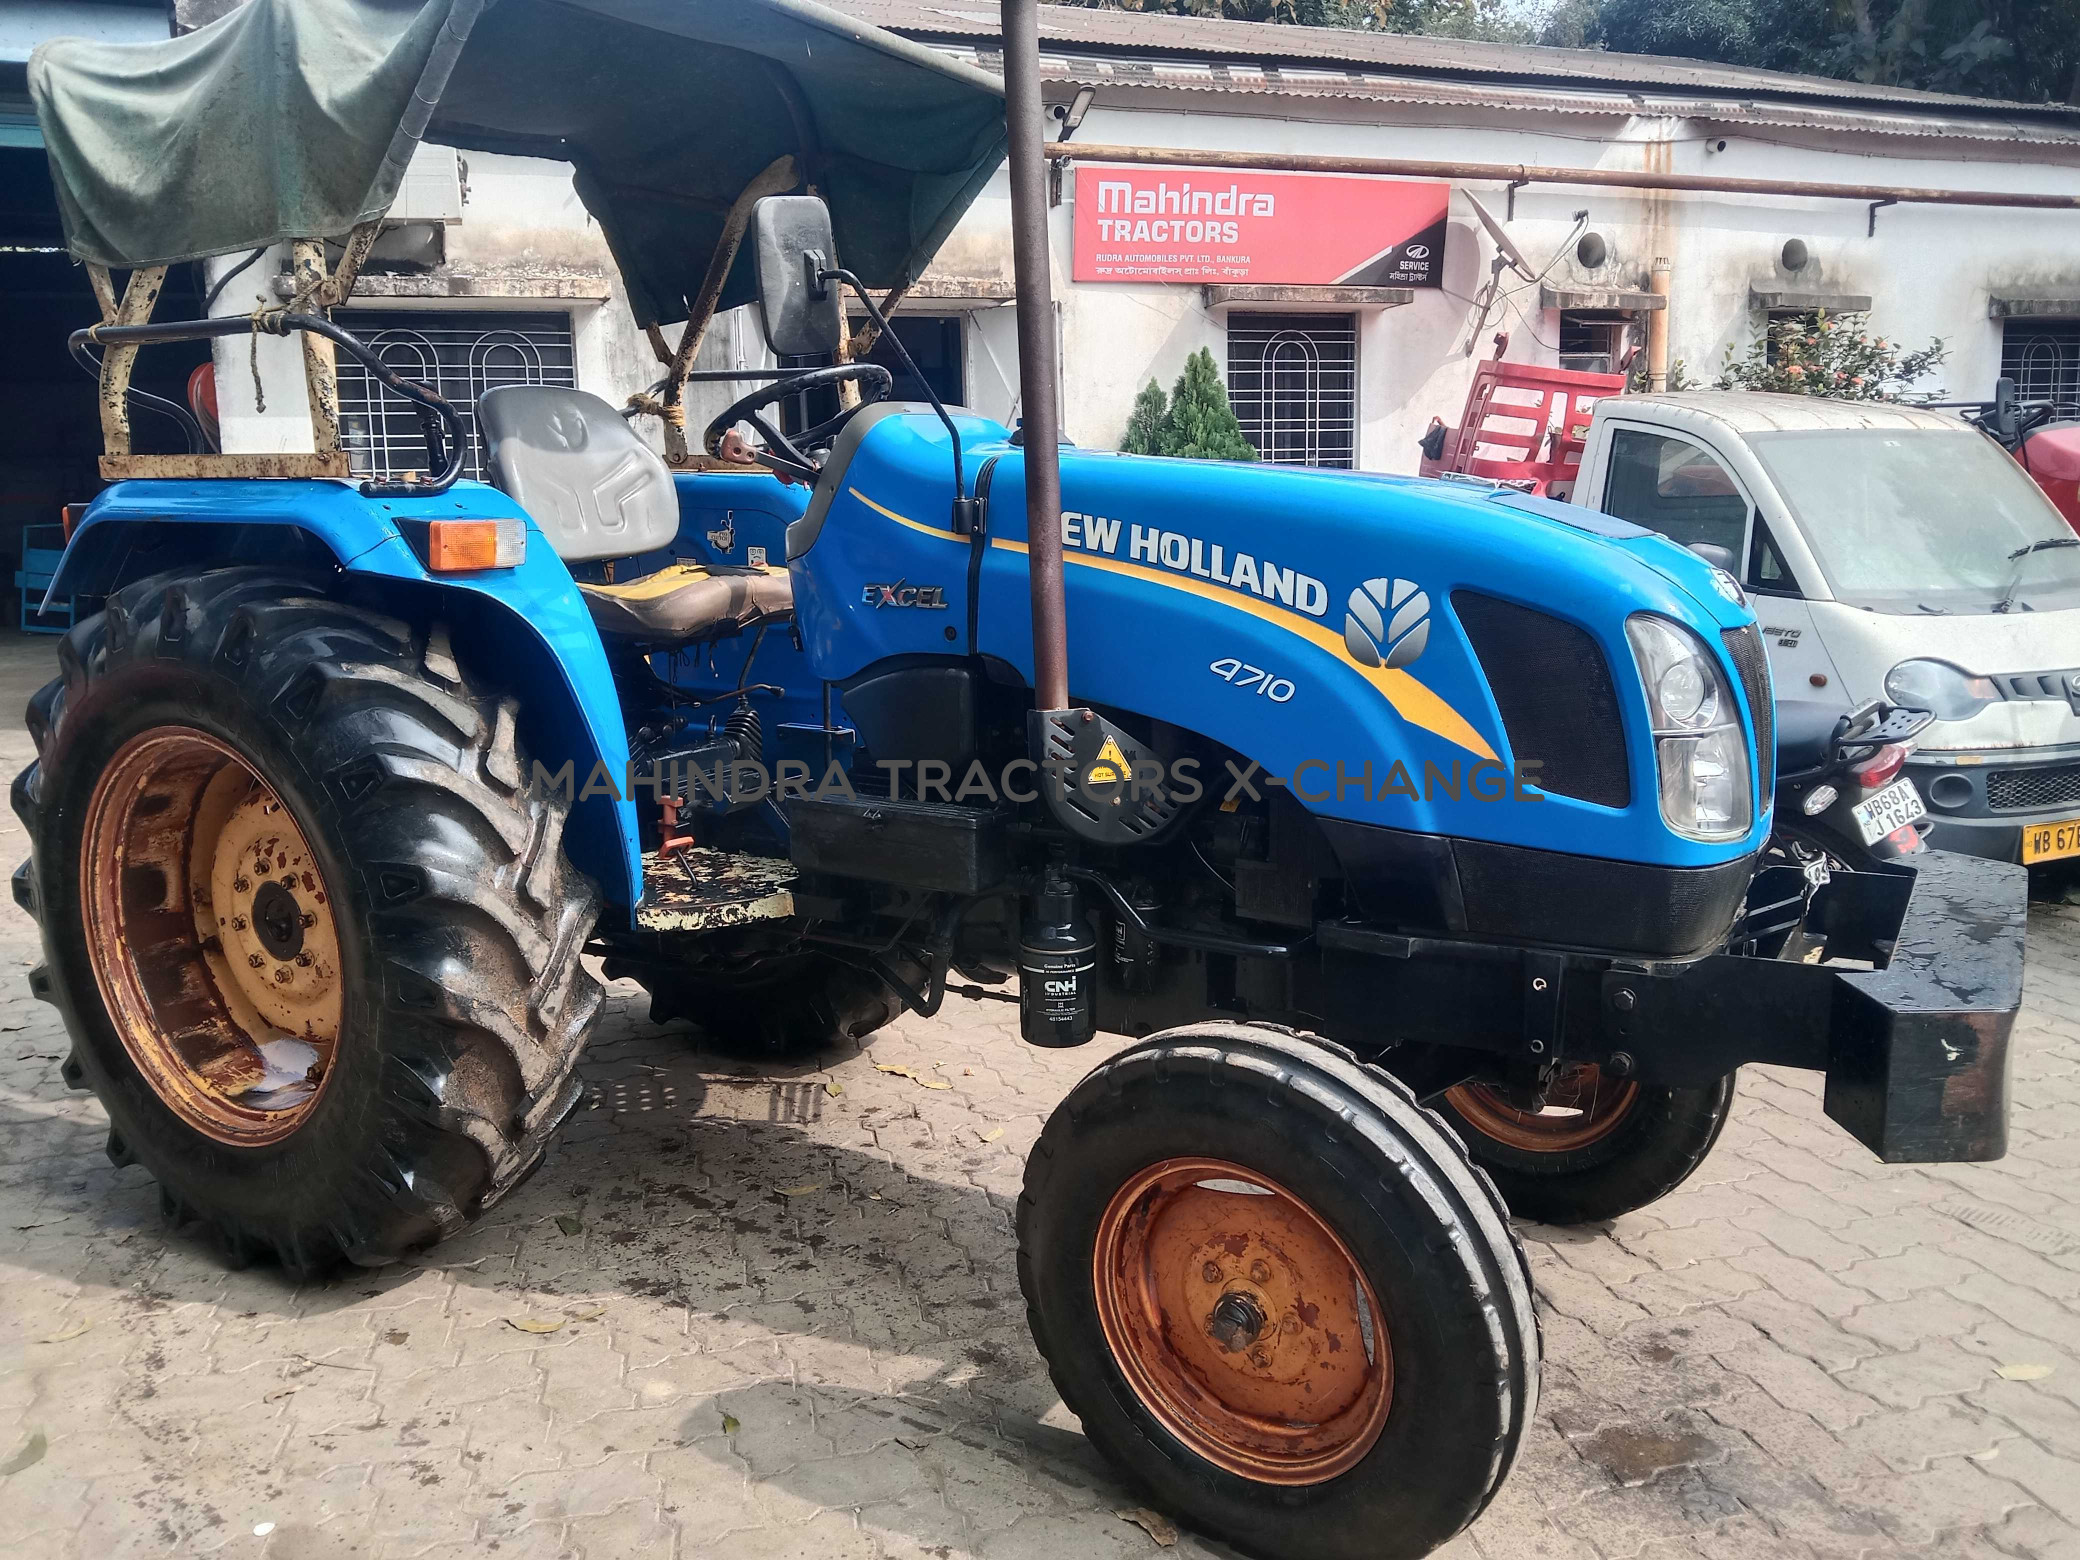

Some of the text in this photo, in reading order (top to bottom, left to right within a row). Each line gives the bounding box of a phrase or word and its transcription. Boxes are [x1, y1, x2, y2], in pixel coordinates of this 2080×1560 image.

[1098, 181, 1275, 217] Mahindra
[1097, 219, 1239, 244] TRACTORS
[1096, 254, 1122, 262] RUDRA
[1124, 254, 1178, 263] AUTOMOBILES
[1217, 255, 1251, 264] BANKURA
[1400, 261, 1429, 270] SERVICE
[1061, 511, 1329, 617] EW HOLLAND
[861, 577, 948, 609] EXCEL
[1209, 657, 1296, 703] 4710
[1863, 785, 1910, 820] WB68A
[2034, 830, 2051, 854] WB
